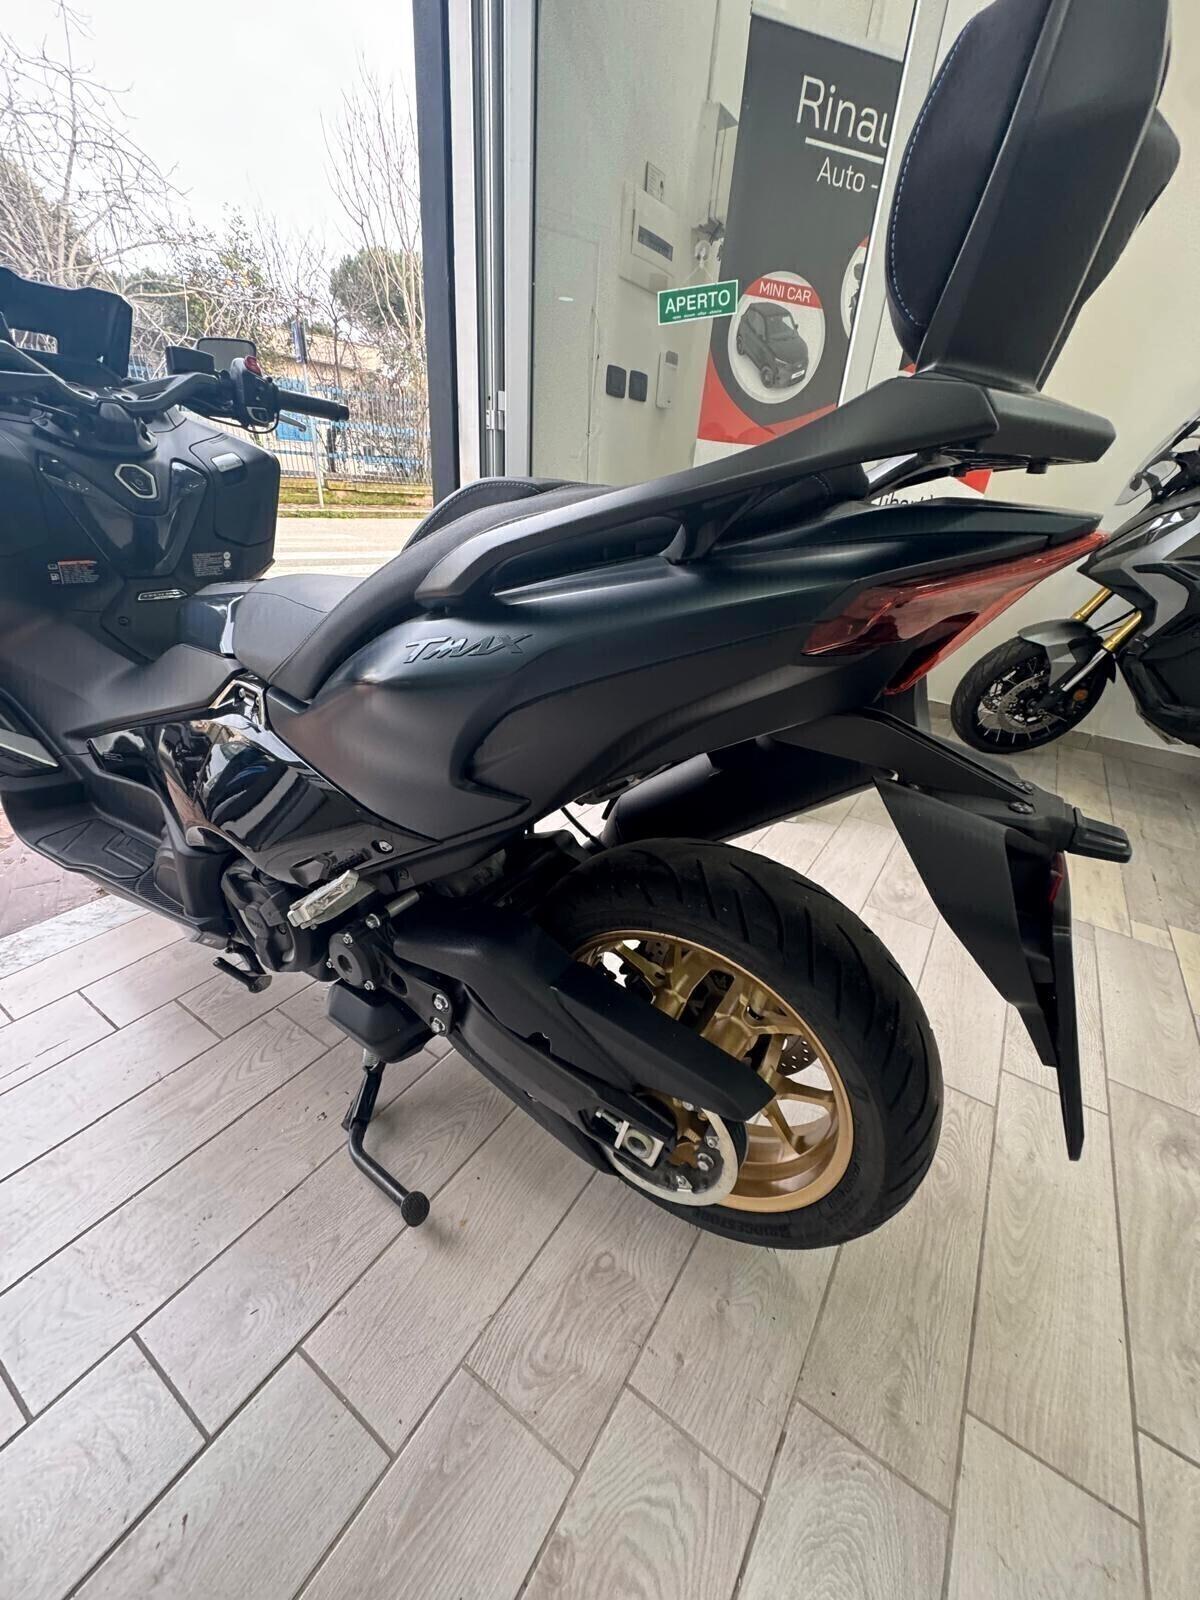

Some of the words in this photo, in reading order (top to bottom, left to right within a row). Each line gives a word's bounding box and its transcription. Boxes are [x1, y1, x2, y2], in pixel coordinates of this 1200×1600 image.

[816, 156, 866, 192] Auto
[664, 289, 731, 314] APERTO
[759, 281, 784, 298] MINI
[786, 287, 812, 304] CAR
[403, 633, 534, 664] TMAX
